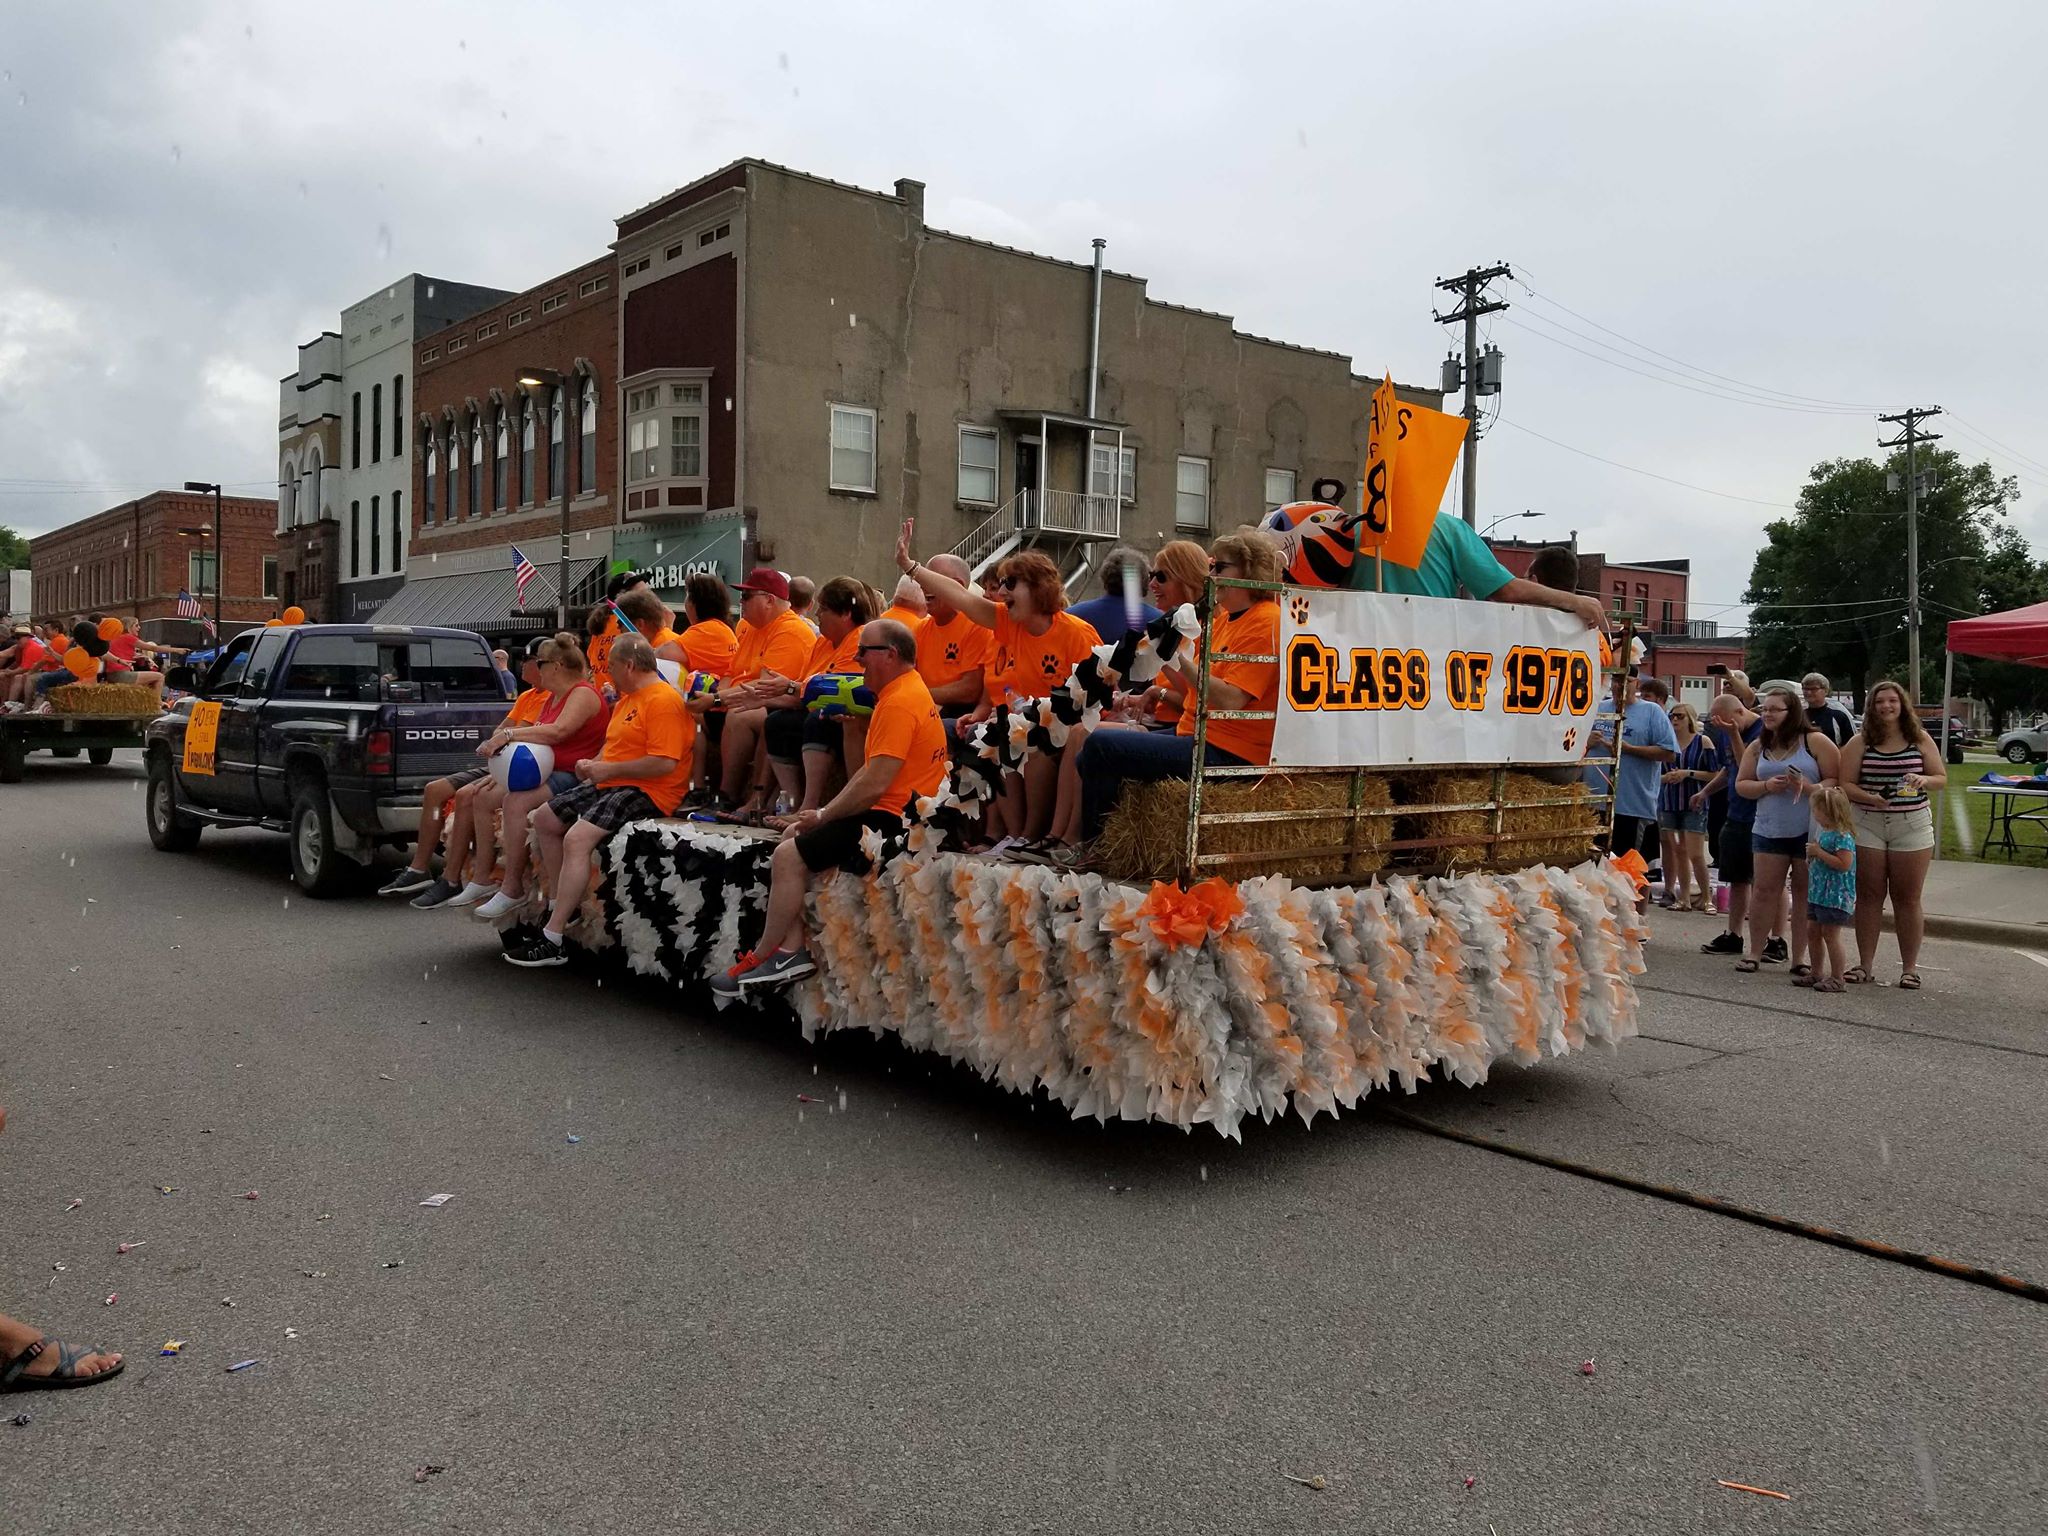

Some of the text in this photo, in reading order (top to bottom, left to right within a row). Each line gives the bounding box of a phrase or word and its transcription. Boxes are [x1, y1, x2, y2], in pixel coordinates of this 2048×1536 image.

[1286, 634, 1594, 716] CLASS OF 1978
[405, 729, 480, 740] DODGE
